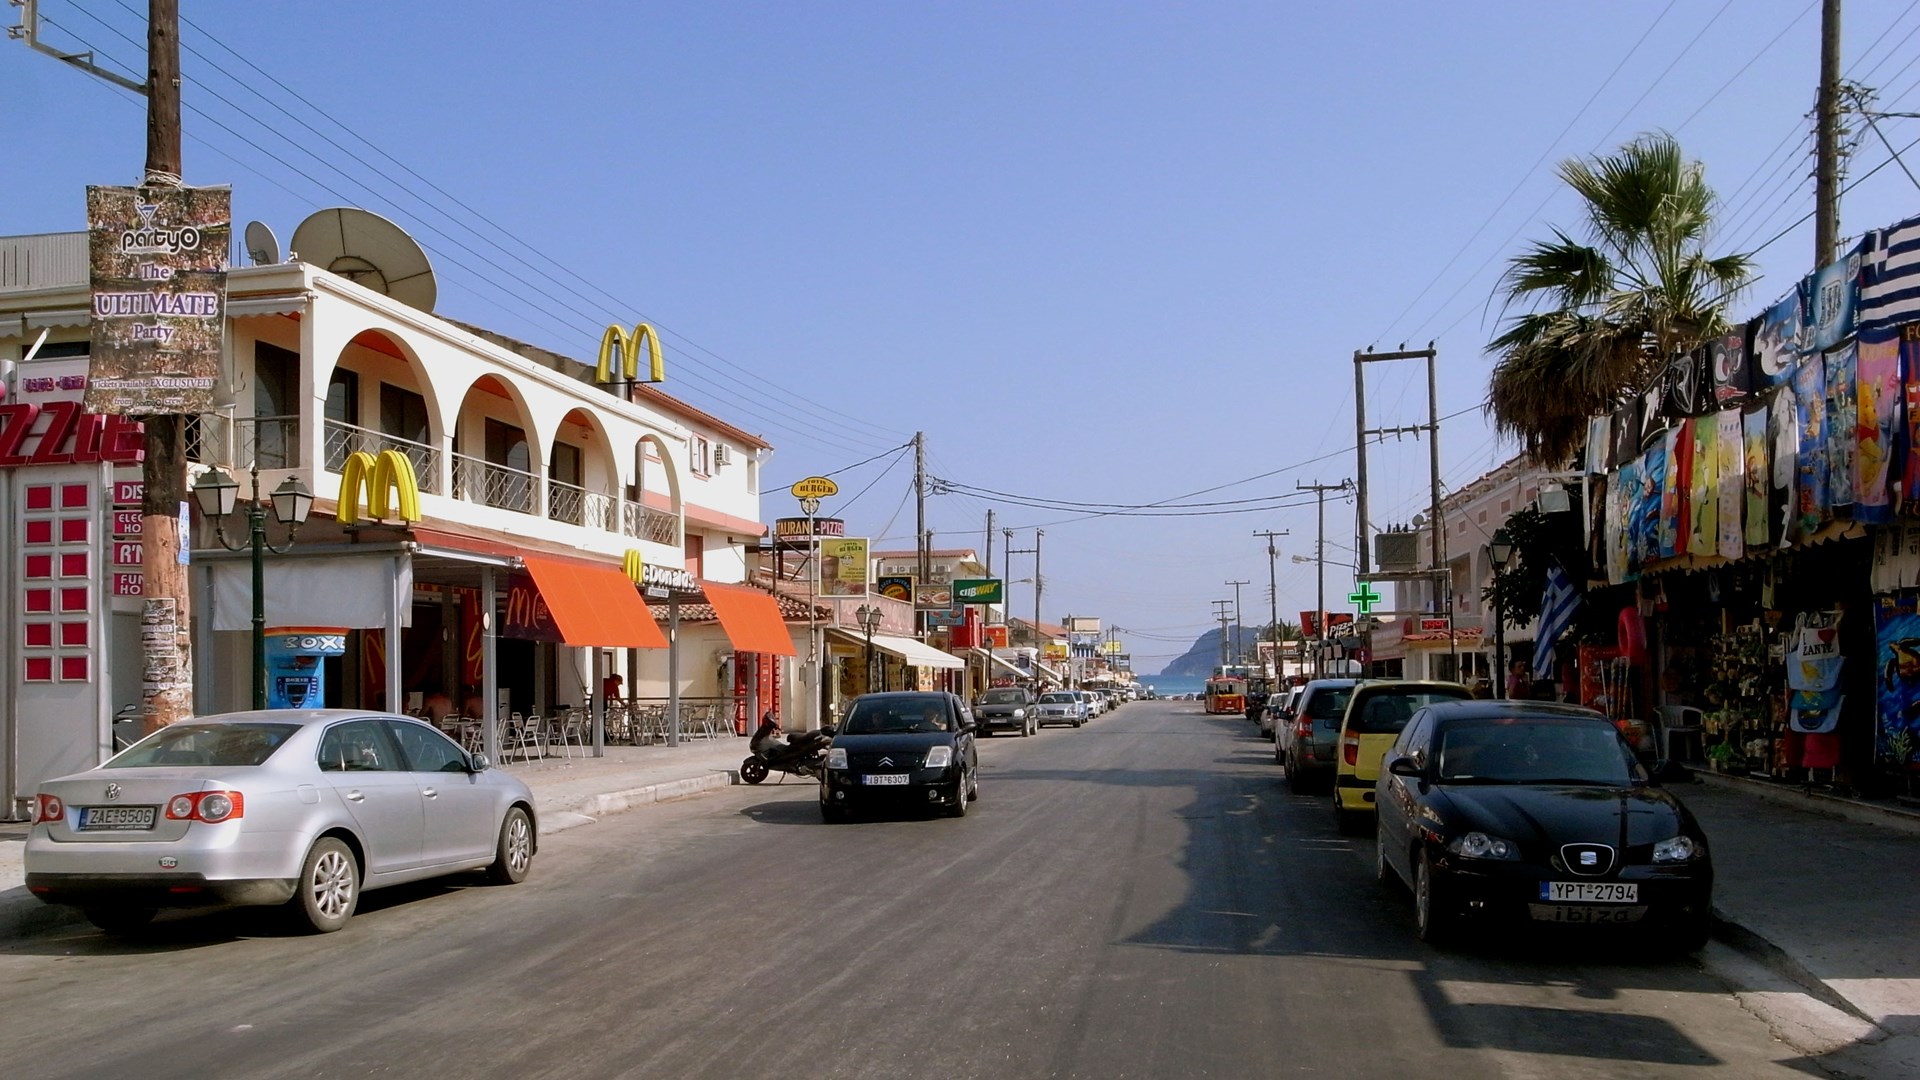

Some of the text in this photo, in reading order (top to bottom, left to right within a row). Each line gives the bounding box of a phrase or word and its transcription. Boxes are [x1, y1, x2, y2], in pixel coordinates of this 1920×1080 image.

[141, 263, 170, 280] The
[95, 293, 217, 315] ULTIMATE
[133, 324, 173, 344] Party
[93, 380, 117, 388] Tickets
[119, 380, 149, 388] available
[150, 378, 213, 388] EXCLUSIVELY
[800, 484, 834, 493] BURGER
[1329, 622, 1353, 637] Pizza
[1334, 628, 1352, 639] Hut
[1802, 644, 1834, 656] ZANTE
[161, 859, 176, 867] BG
